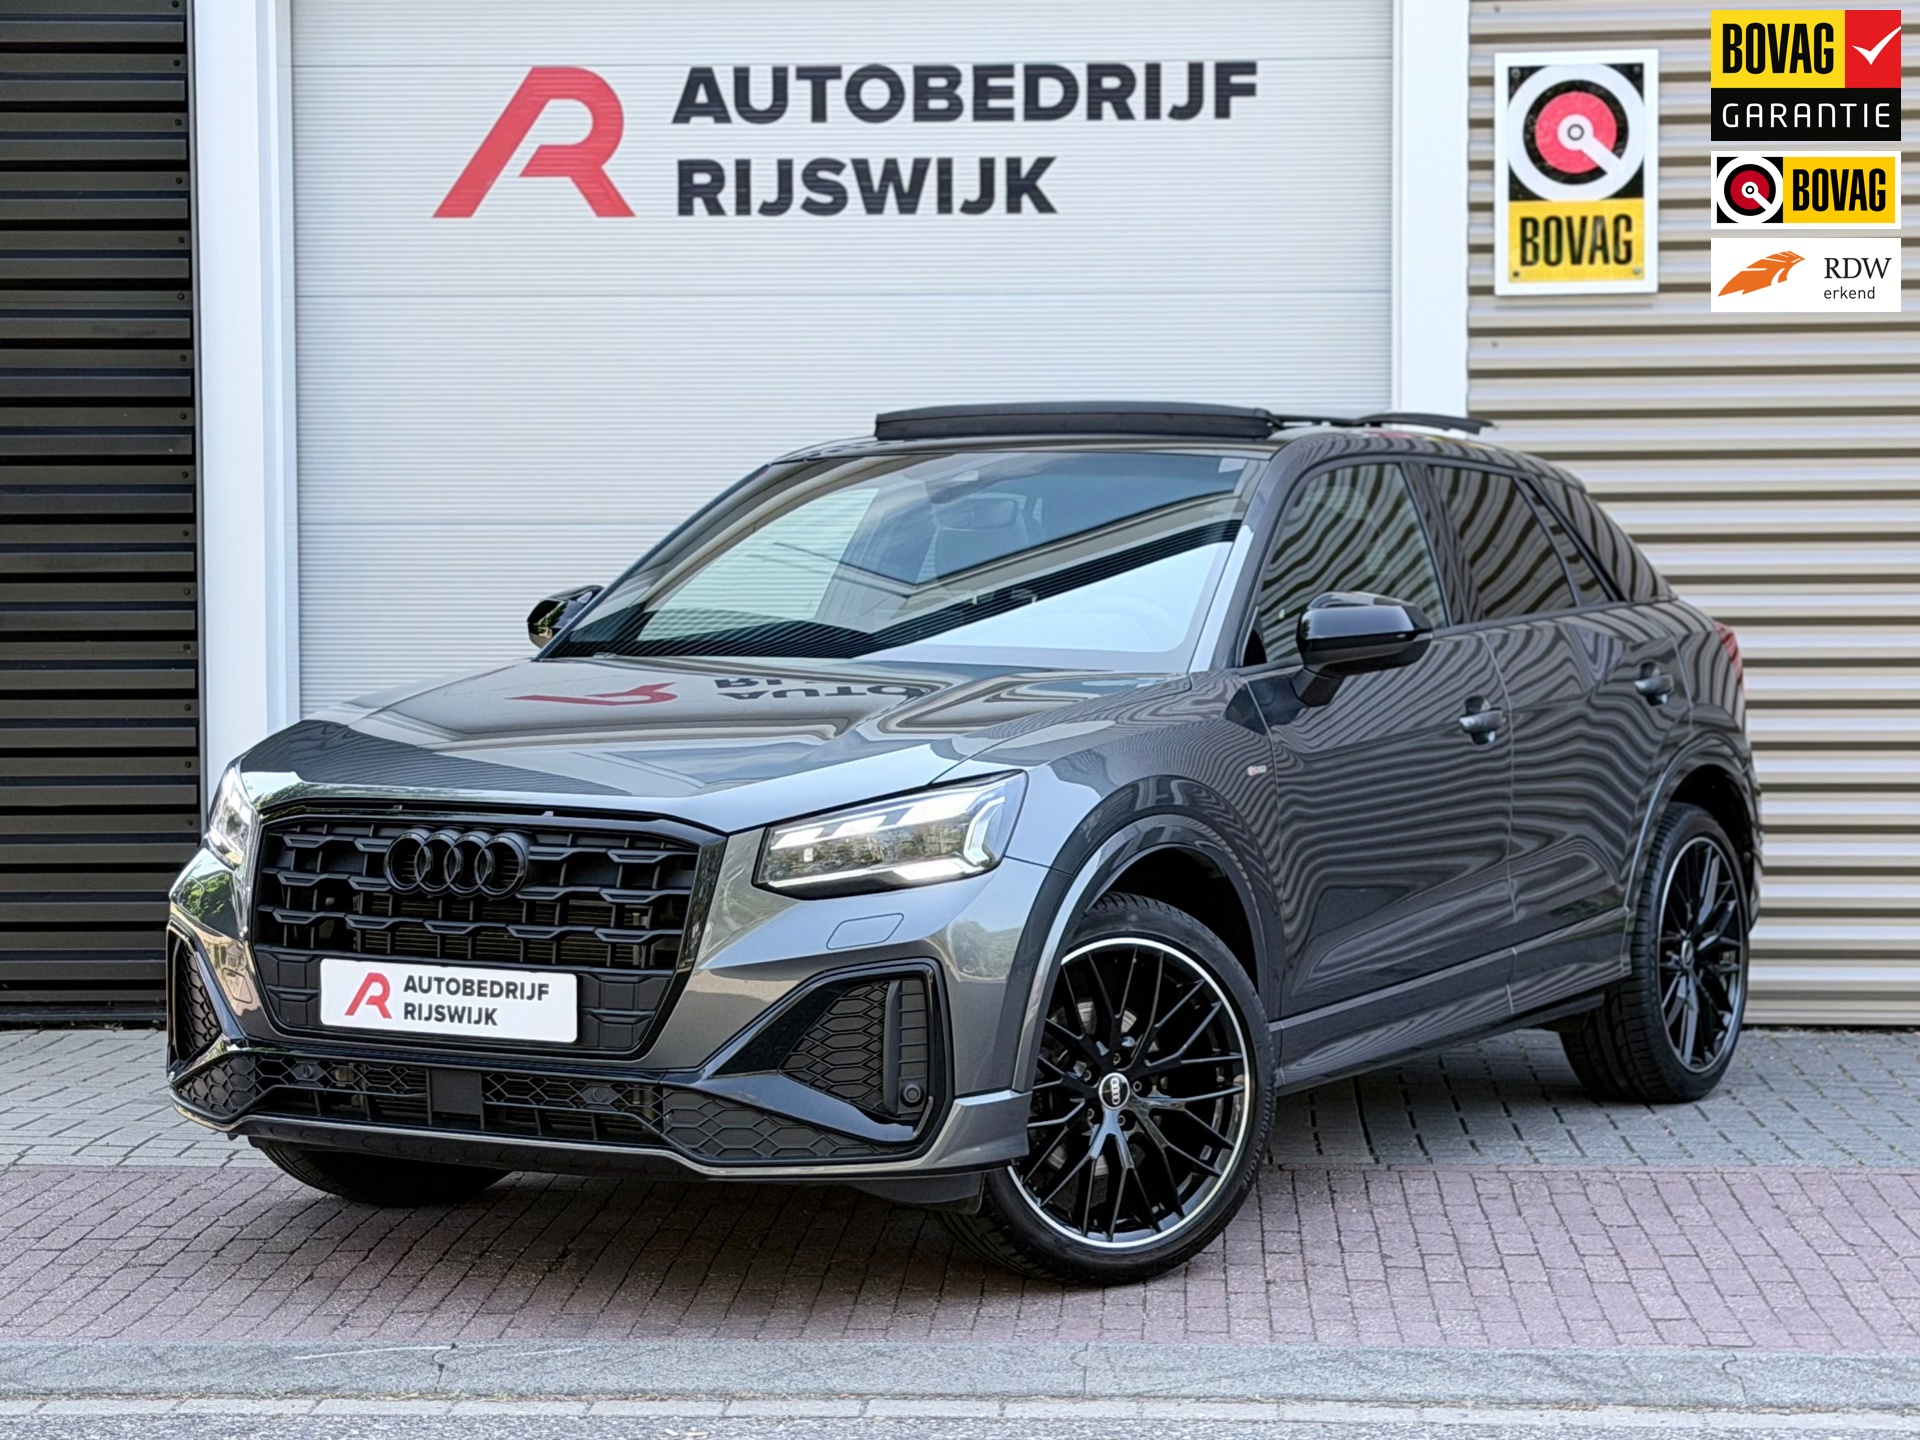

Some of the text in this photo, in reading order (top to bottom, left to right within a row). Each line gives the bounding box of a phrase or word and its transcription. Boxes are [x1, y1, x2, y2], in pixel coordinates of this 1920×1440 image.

[672, 61, 1258, 124] AUTOBEDRIJF
[677, 156, 1057, 217] RIJSWIJK
[1519, 213, 1633, 267] BOVAG
[403, 974, 550, 1001] AUTOBEDRIJF
[403, 1002, 498, 1026] RIJSWIJK
